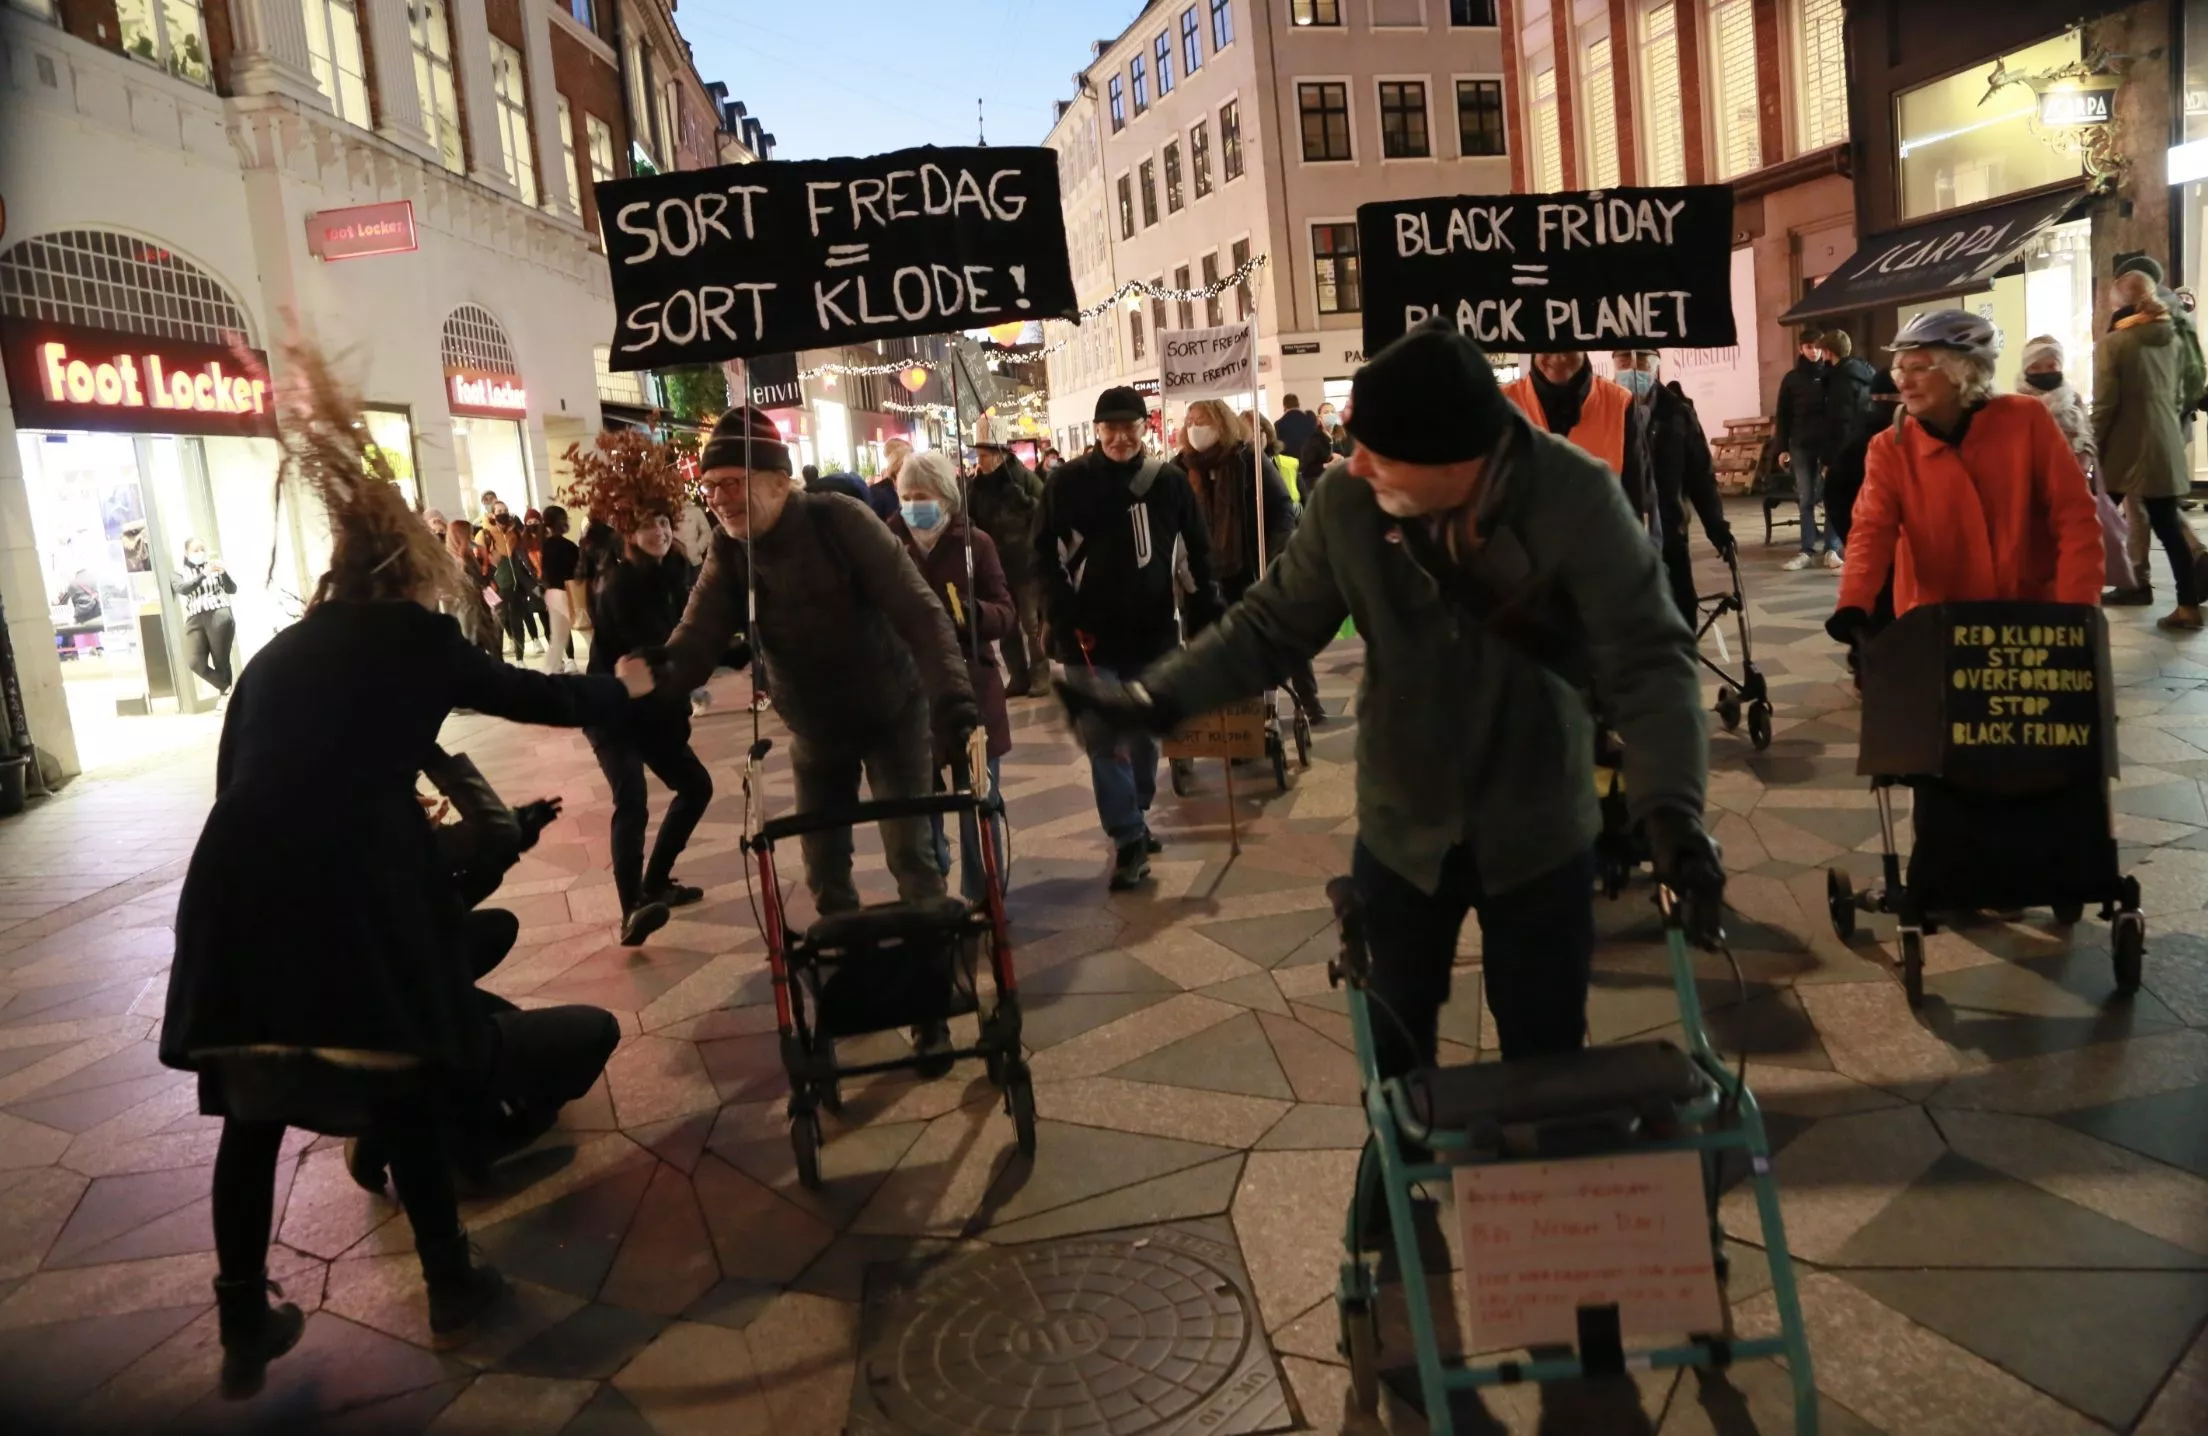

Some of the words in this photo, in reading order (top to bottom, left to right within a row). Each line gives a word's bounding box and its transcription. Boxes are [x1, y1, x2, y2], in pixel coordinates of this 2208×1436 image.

[617, 185, 768, 265] SORT
[806, 163, 1027, 237] FREDAG
[357, 220, 403, 238] Locker
[1395, 206, 1516, 257] BLACK
[824, 243, 870, 268] =
[1847, 219, 2016, 281] SCARPA
[1511, 264, 1549, 286] =
[621, 283, 778, 352] SORT
[1545, 290, 1692, 341] PLANET
[1167, 339, 1208, 358] SORT
[40, 341, 144, 406] Foot
[144, 353, 264, 414] Locker
[1165, 371, 1197, 387] SORT
[1202, 358, 1248, 383] FREMTID
[1953, 625, 1996, 646] RED
[1988, 647, 2049, 667] STOP
[1952, 668, 2093, 691] OVERFORBRUG
[1988, 696, 2050, 715] STOP
[1952, 722, 2016, 745] BLACK
[2023, 722, 2092, 745] FRIDAY
